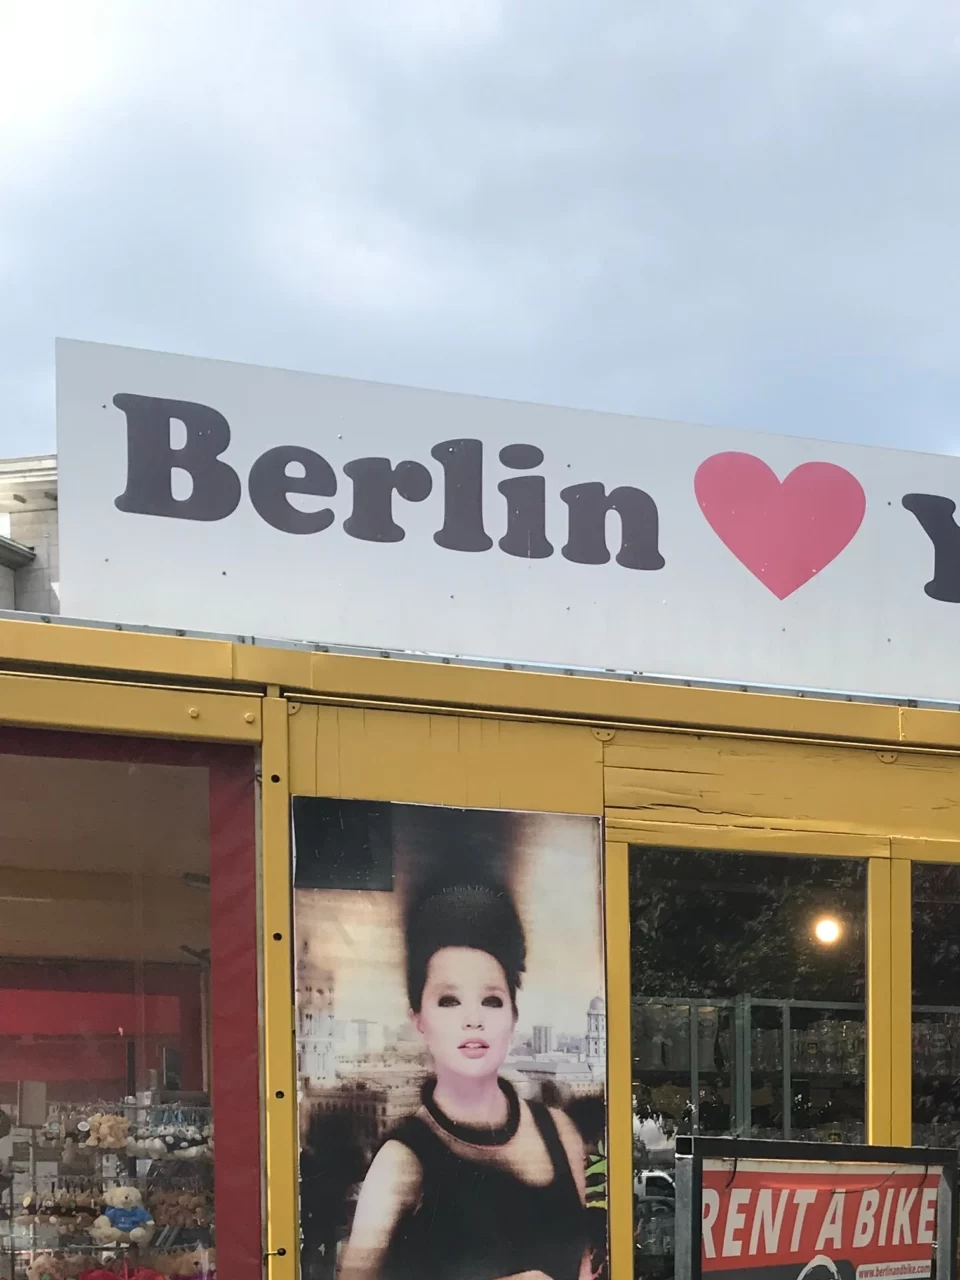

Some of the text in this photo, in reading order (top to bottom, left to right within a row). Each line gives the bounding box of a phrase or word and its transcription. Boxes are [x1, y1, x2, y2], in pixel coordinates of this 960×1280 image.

[112, 393, 666, 570] Berlin
[702, 1187, 938, 1259] RENT A BIKE
[858, 1263, 931, 1280] www.berlinandbike.com
